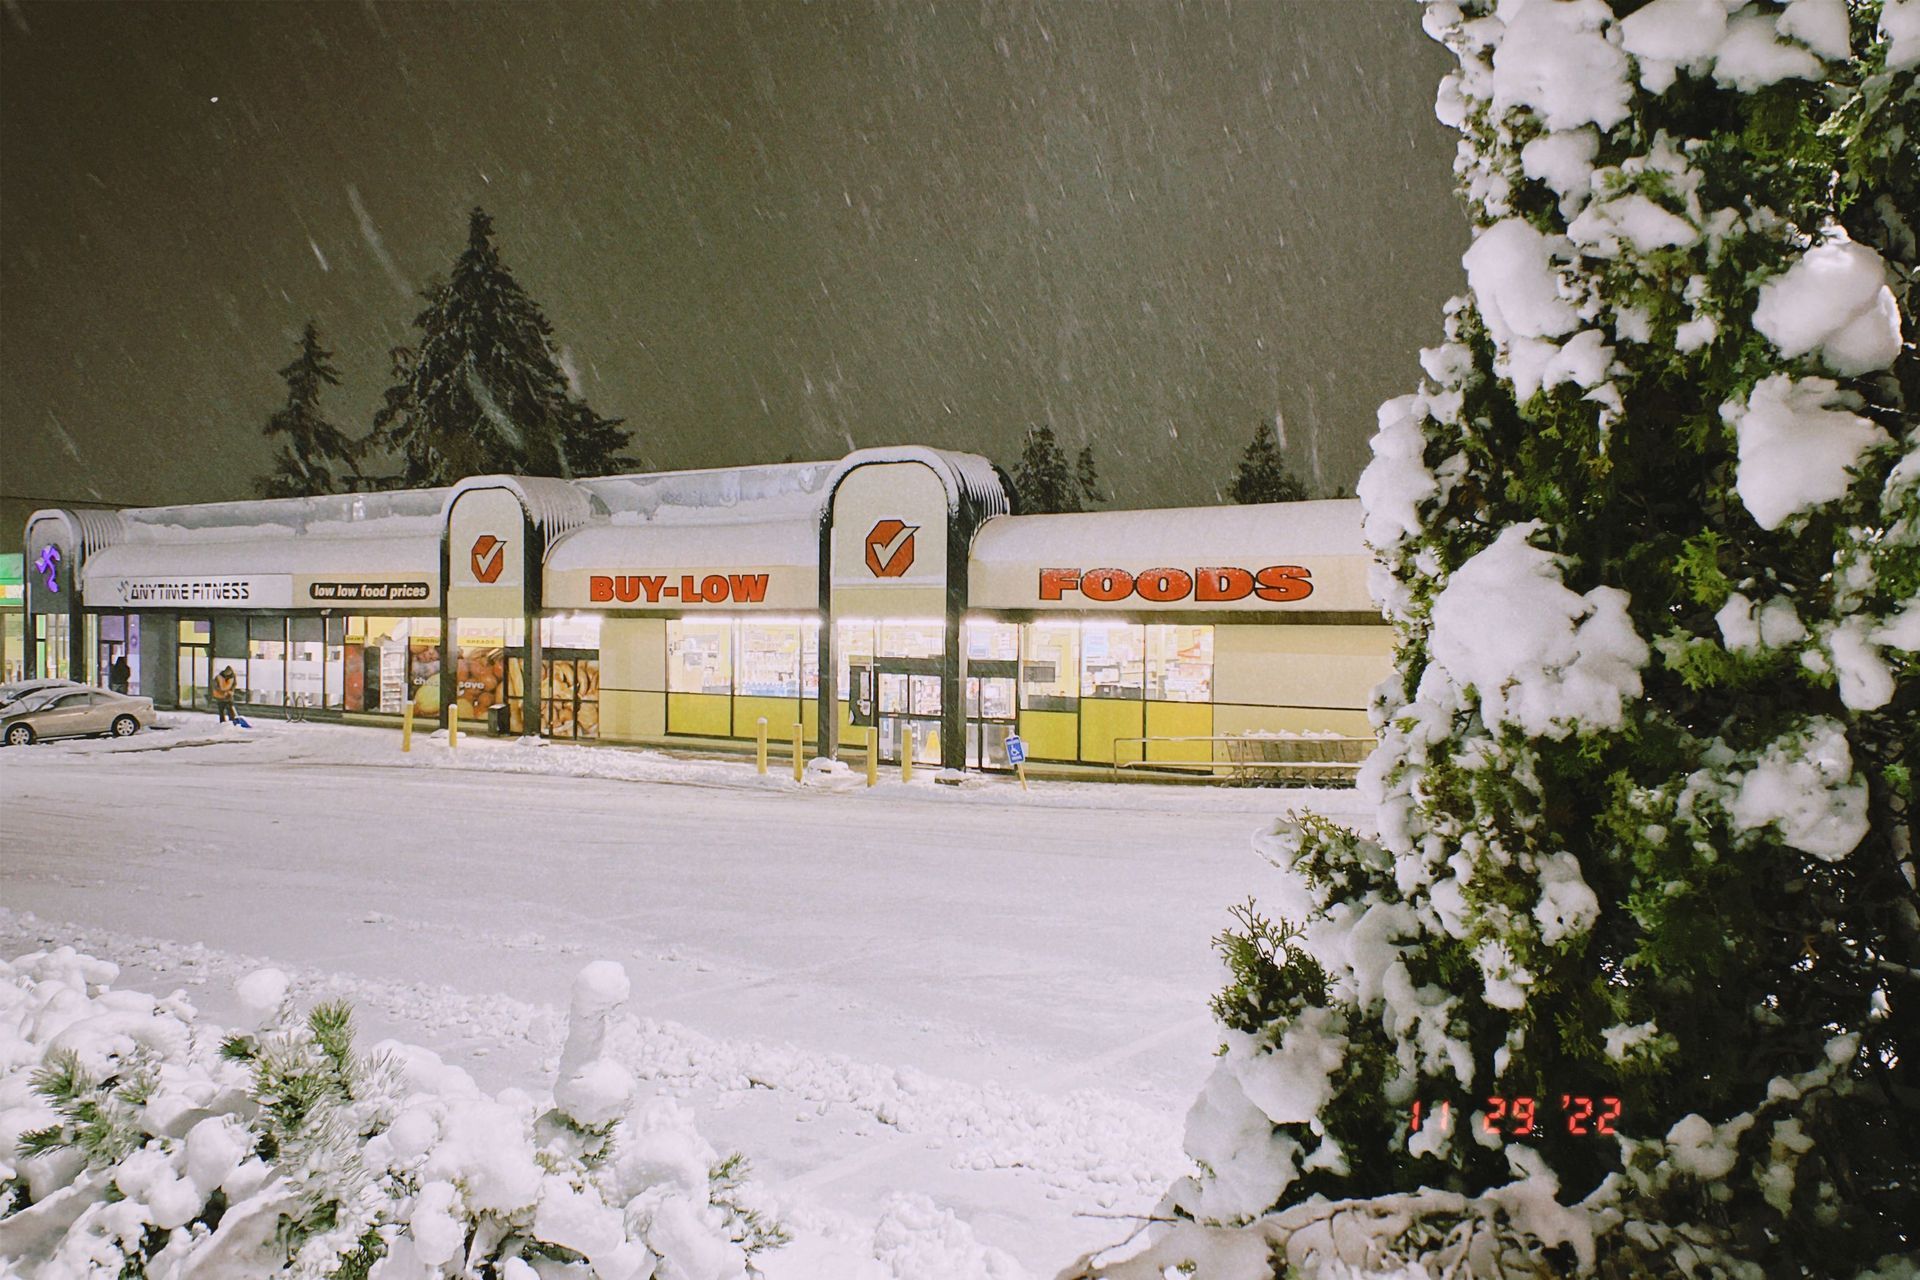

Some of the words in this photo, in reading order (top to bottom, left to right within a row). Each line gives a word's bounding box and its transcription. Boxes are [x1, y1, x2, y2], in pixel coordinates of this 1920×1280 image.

[131, 583, 189, 600] ANYTIME
[192, 582, 249, 600] FITNESS
[314, 584, 335, 597] low
[337, 584, 358, 597] low
[361, 584, 387, 597] food
[389, 584, 427, 600] prices
[590, 574, 769, 603] BUY-LOW
[1039, 565, 1314, 602] FOODS
